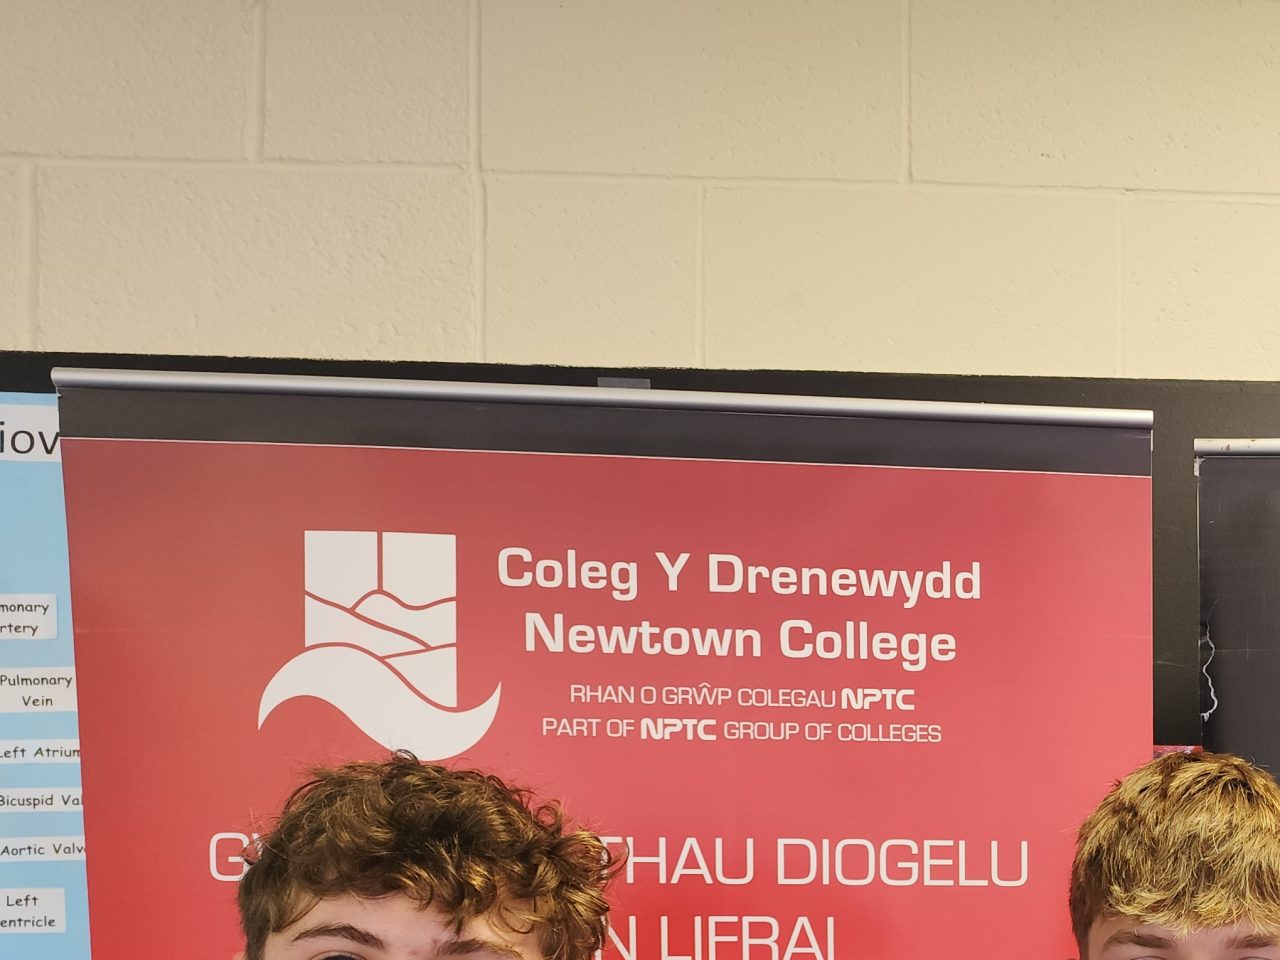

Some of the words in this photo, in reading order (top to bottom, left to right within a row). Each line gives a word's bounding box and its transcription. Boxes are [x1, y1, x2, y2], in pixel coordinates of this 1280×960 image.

[0, 421, 60, 455] iov
[498, 547, 638, 601] Coleg
[655, 552, 691, 591] Y
[708, 553, 981, 609] Drenewydd
[0, 603, 49, 616] monary
[0, 623, 38, 637] rtery
[525, 612, 761, 657] Newtown
[779, 619, 956, 672] College
[0, 674, 73, 688] Pulmonary
[22, 695, 54, 707] Vein
[570, 684, 635, 704] RHAN
[640, 685, 657, 705] O
[737, 688, 836, 708] COLEGAU
[841, 687, 915, 711] NPTC
[542, 717, 602, 737] PART
[606, 718, 635, 737] OF
[640, 717, 717, 741] NPTC
[723, 721, 800, 741] GROUP
[804, 722, 832, 741] OF
[837, 723, 942, 743] COLLEGES
[0, 746, 26, 759] eft
[1, 844, 45, 856] Aortic
[777, 838, 1028, 887] DIOGELU
[7, 894, 39, 907] Left
[0, 915, 56, 928] entricle
